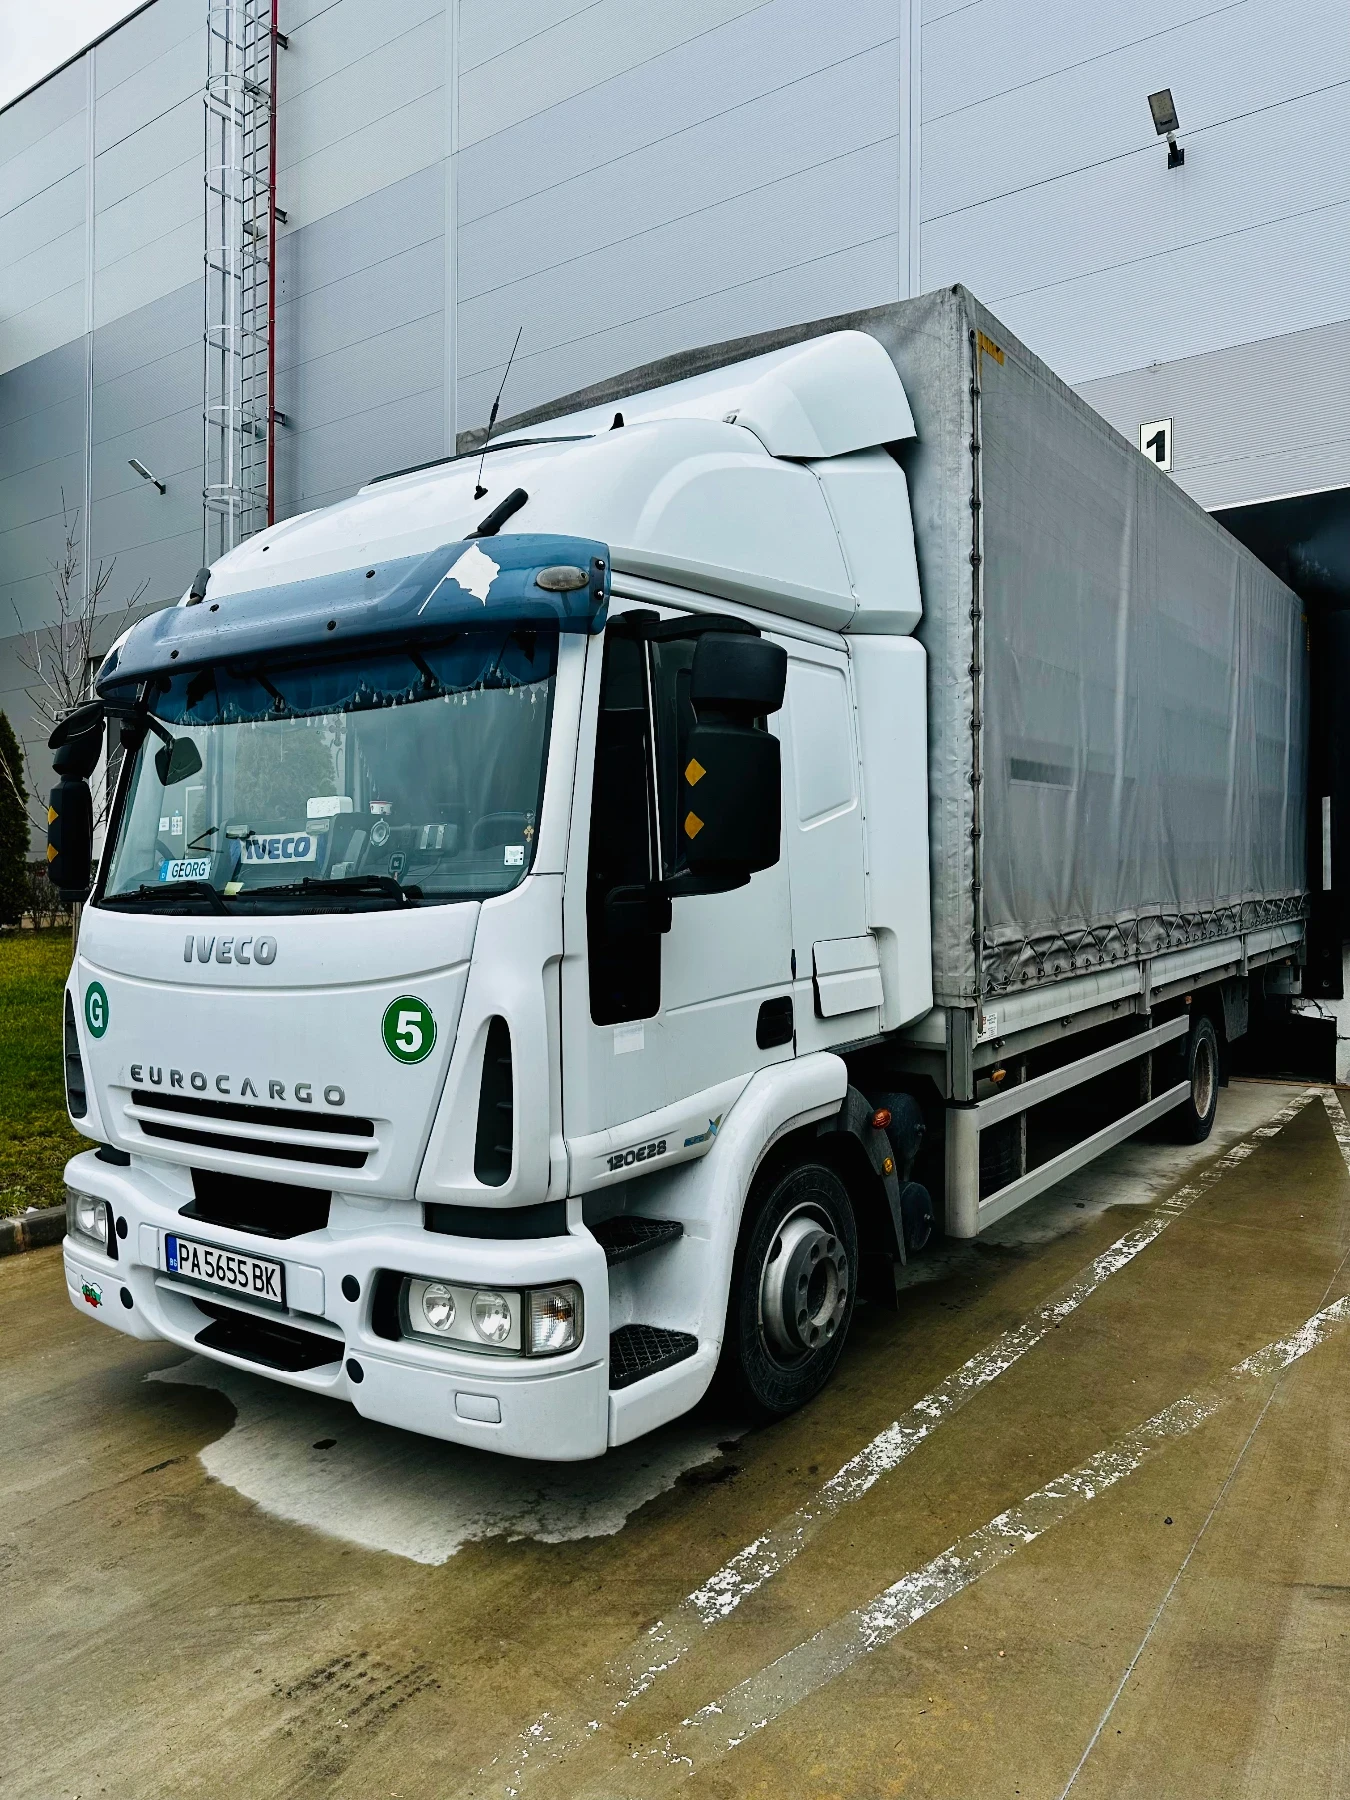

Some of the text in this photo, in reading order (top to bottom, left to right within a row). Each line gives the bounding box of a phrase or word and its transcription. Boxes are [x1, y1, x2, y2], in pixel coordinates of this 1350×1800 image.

[1146, 430, 1165, 462] 1
[247, 836, 311, 860] IVECO
[171, 862, 206, 878] GEORG
[184, 935, 278, 966] IVECO
[89, 991, 104, 1028] G
[395, 1011, 423, 1053] 5
[130, 1064, 346, 1107] EUROCARGO
[606, 1139, 667, 1171] 120E28
[169, 1257, 178, 1267] BG
[204, 1251, 249, 1288] 5655
